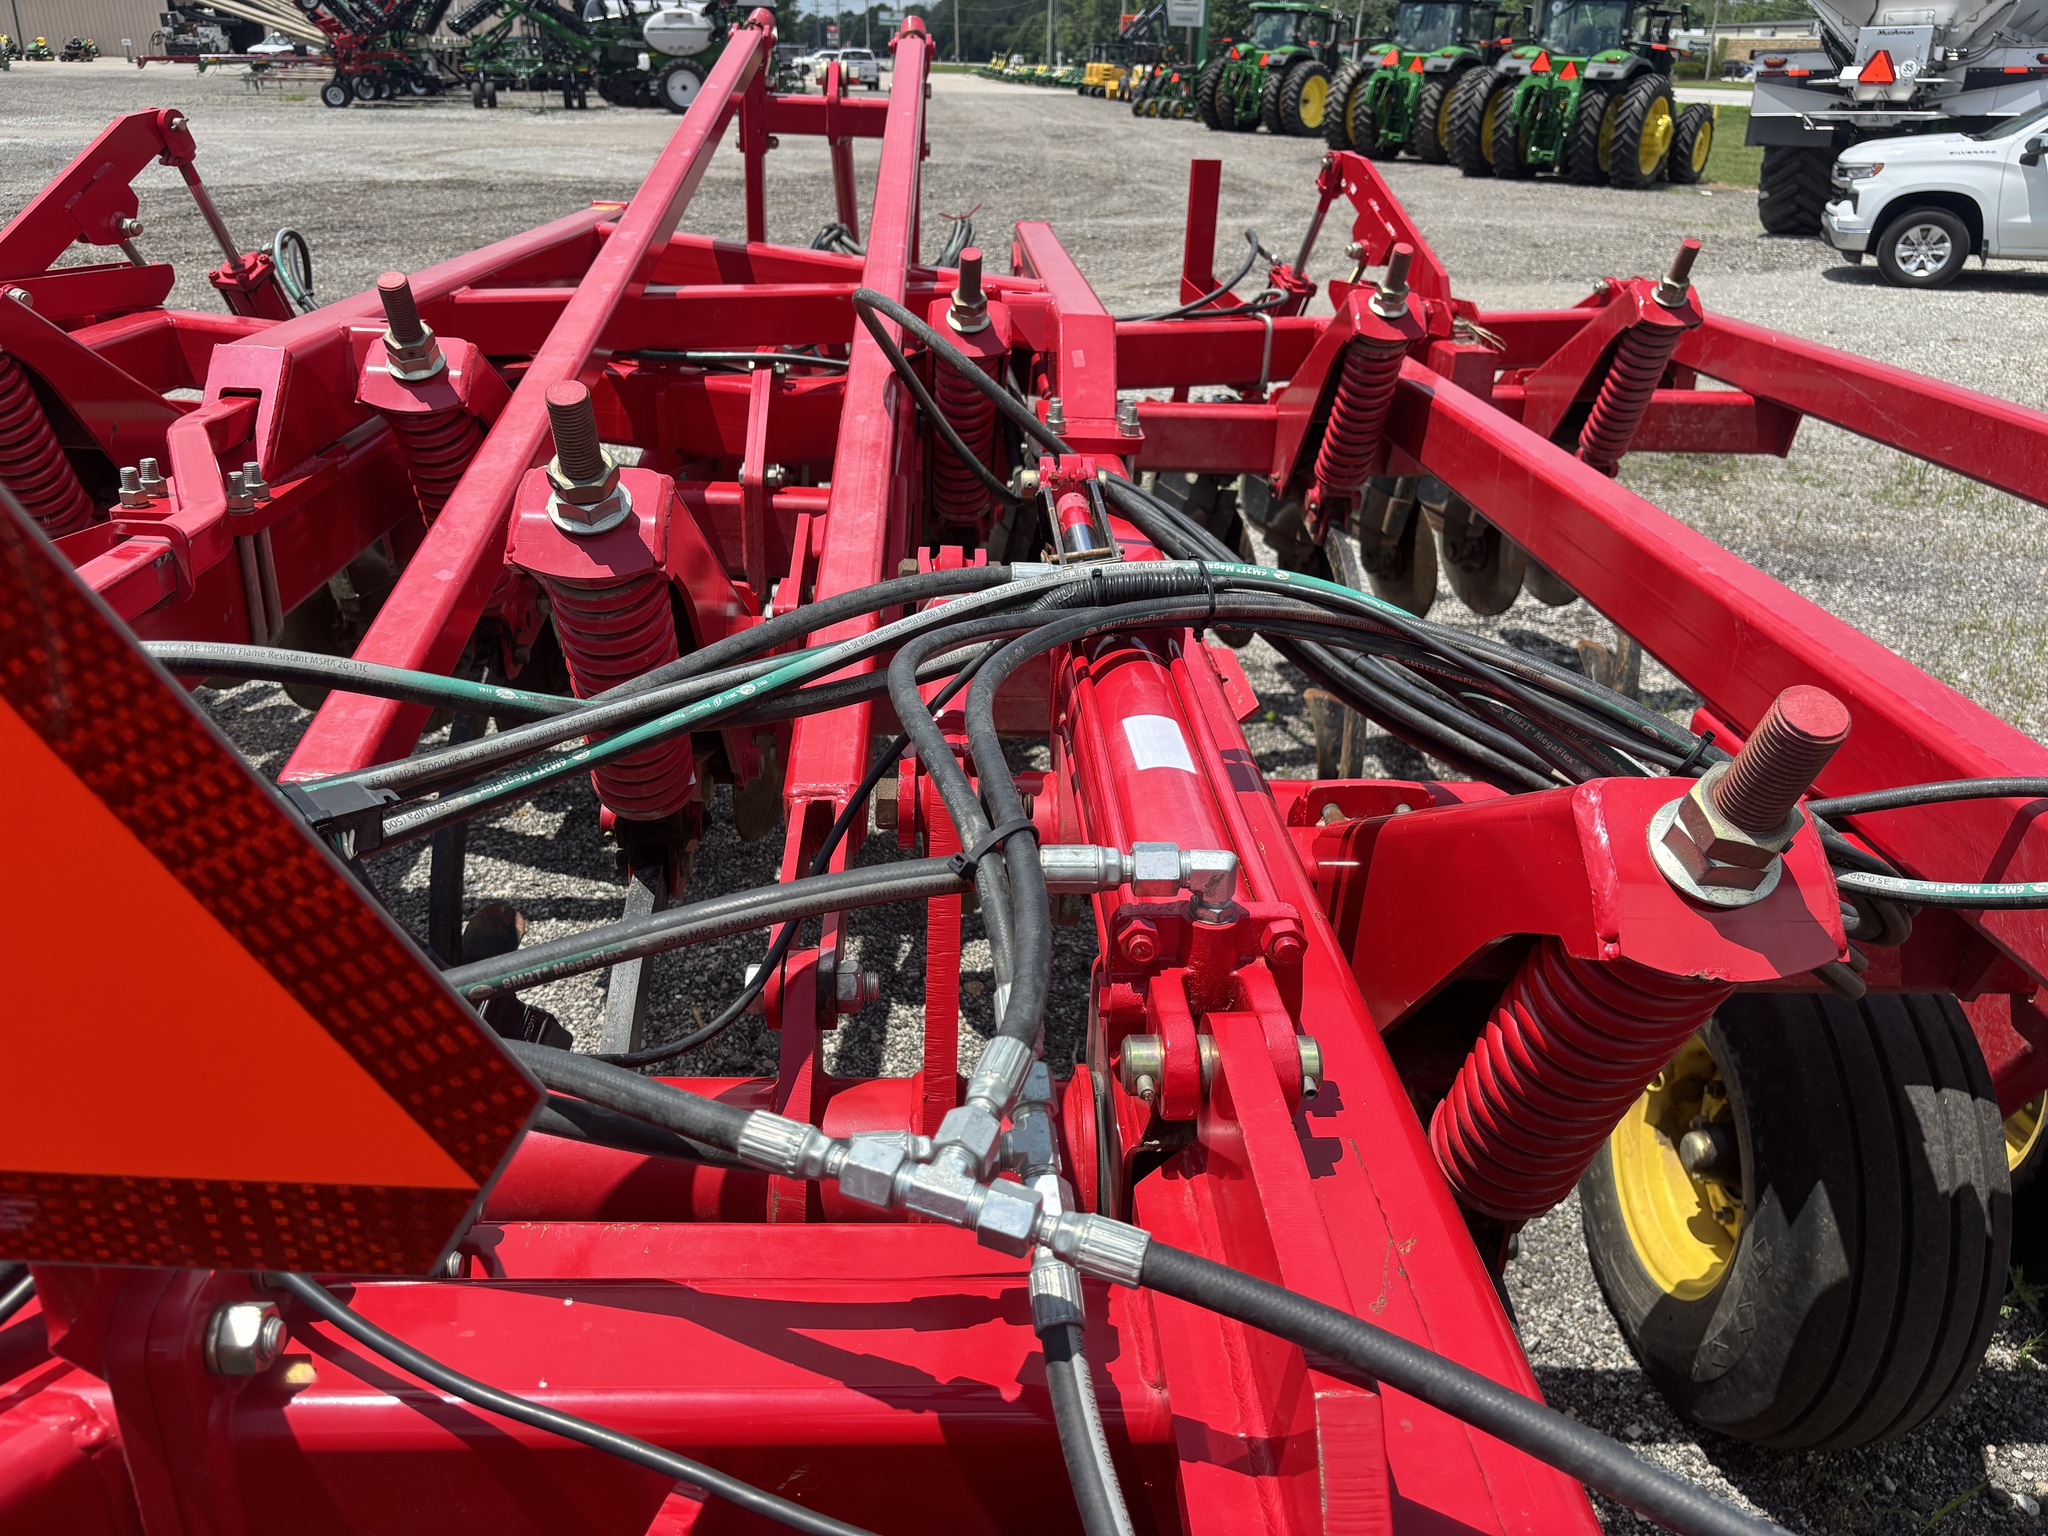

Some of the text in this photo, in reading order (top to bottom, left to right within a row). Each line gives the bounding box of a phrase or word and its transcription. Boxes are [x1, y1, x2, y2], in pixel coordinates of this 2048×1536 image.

[183, 644, 199, 652] SAE
[238, 647, 265, 658] Flame
[267, 650, 308, 663] Resistant
[309, 656, 336, 667] MSHA
[368, 772, 392, 788] 35.0
[393, 765, 417, 782] MPa
[416, 757, 448, 776] (5000
[508, 734, 532, 750] mm)
[405, 807, 429, 823] MPa
[429, 798, 451, 814] 35.0
[660, 931, 687, 947] 29.6
[688, 924, 716, 940] MPa
[717, 915, 752, 933] (4300
[752, 909, 776, 924] PSI)
